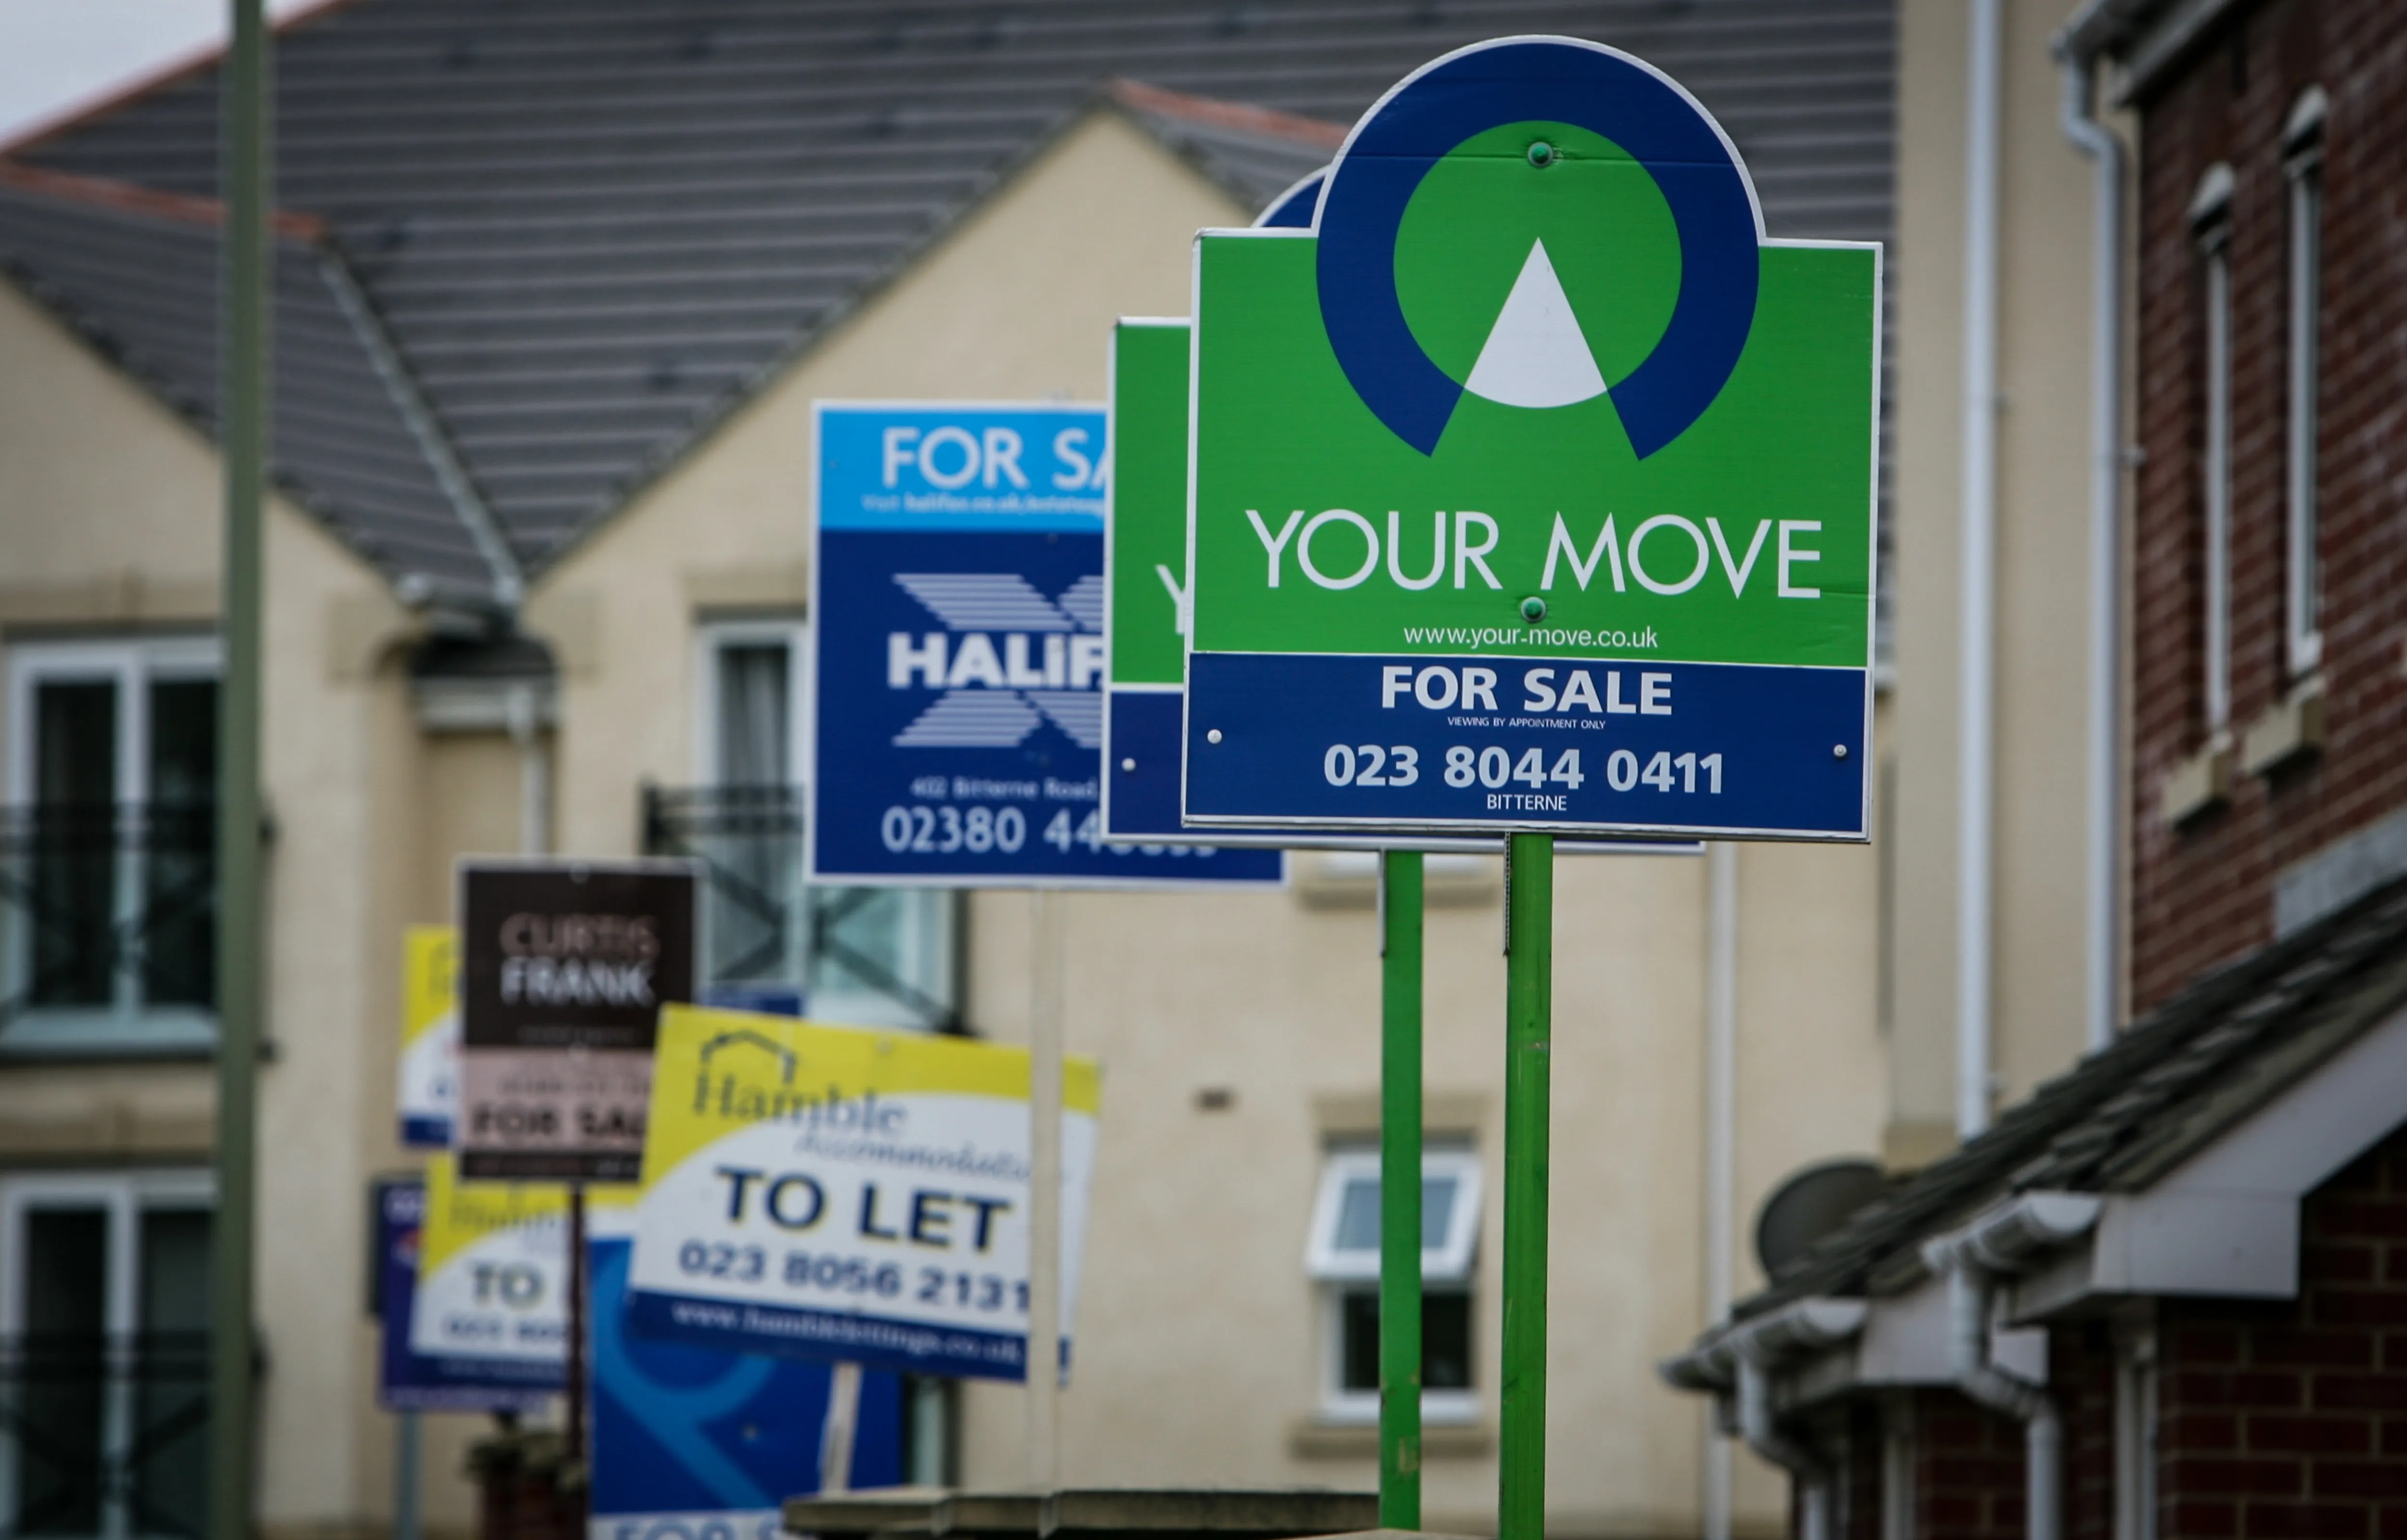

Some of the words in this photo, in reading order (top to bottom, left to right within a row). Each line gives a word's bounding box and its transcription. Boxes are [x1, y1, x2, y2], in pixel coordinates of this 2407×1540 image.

[882, 425, 1030, 491] FOR
[1051, 427, 1105, 491] S
[1245, 509, 1503, 590] YOUR
[1540, 511, 1822, 599] MOVE
[887, 631, 1103, 689] HALIF
[1404, 626, 1658, 649] www.your-move.co.uk
[1382, 666, 1498, 710] FOR
[1524, 668, 1672, 715] SALE
[1448, 716, 1489, 727] VIEWING
[1494, 718, 1505, 727] BY
[1509, 718, 1577, 729] APPOINTMENT
[1581, 719, 1605, 730] ONLY
[952, 776, 1040, 801] Bitterne
[1324, 744, 1419, 786] 023
[1445, 746, 1584, 790] 8044
[1606, 749, 1722, 794] 0411
[1487, 794, 1567, 811] BITTERNE
[881, 805, 1027, 854] 02380
[499, 912, 660, 956] CURTIS
[500, 956, 656, 1006] FRANK
[693, 1072, 908, 1130] Hamble
[714, 1162, 828, 1231] TO
[857, 1181, 1014, 1254] LET
[468, 1259, 548, 1311] TO
[679, 1240, 765, 1282] 023
[783, 1250, 903, 1298] 8056
[915, 1264, 1030, 1314] 2131
